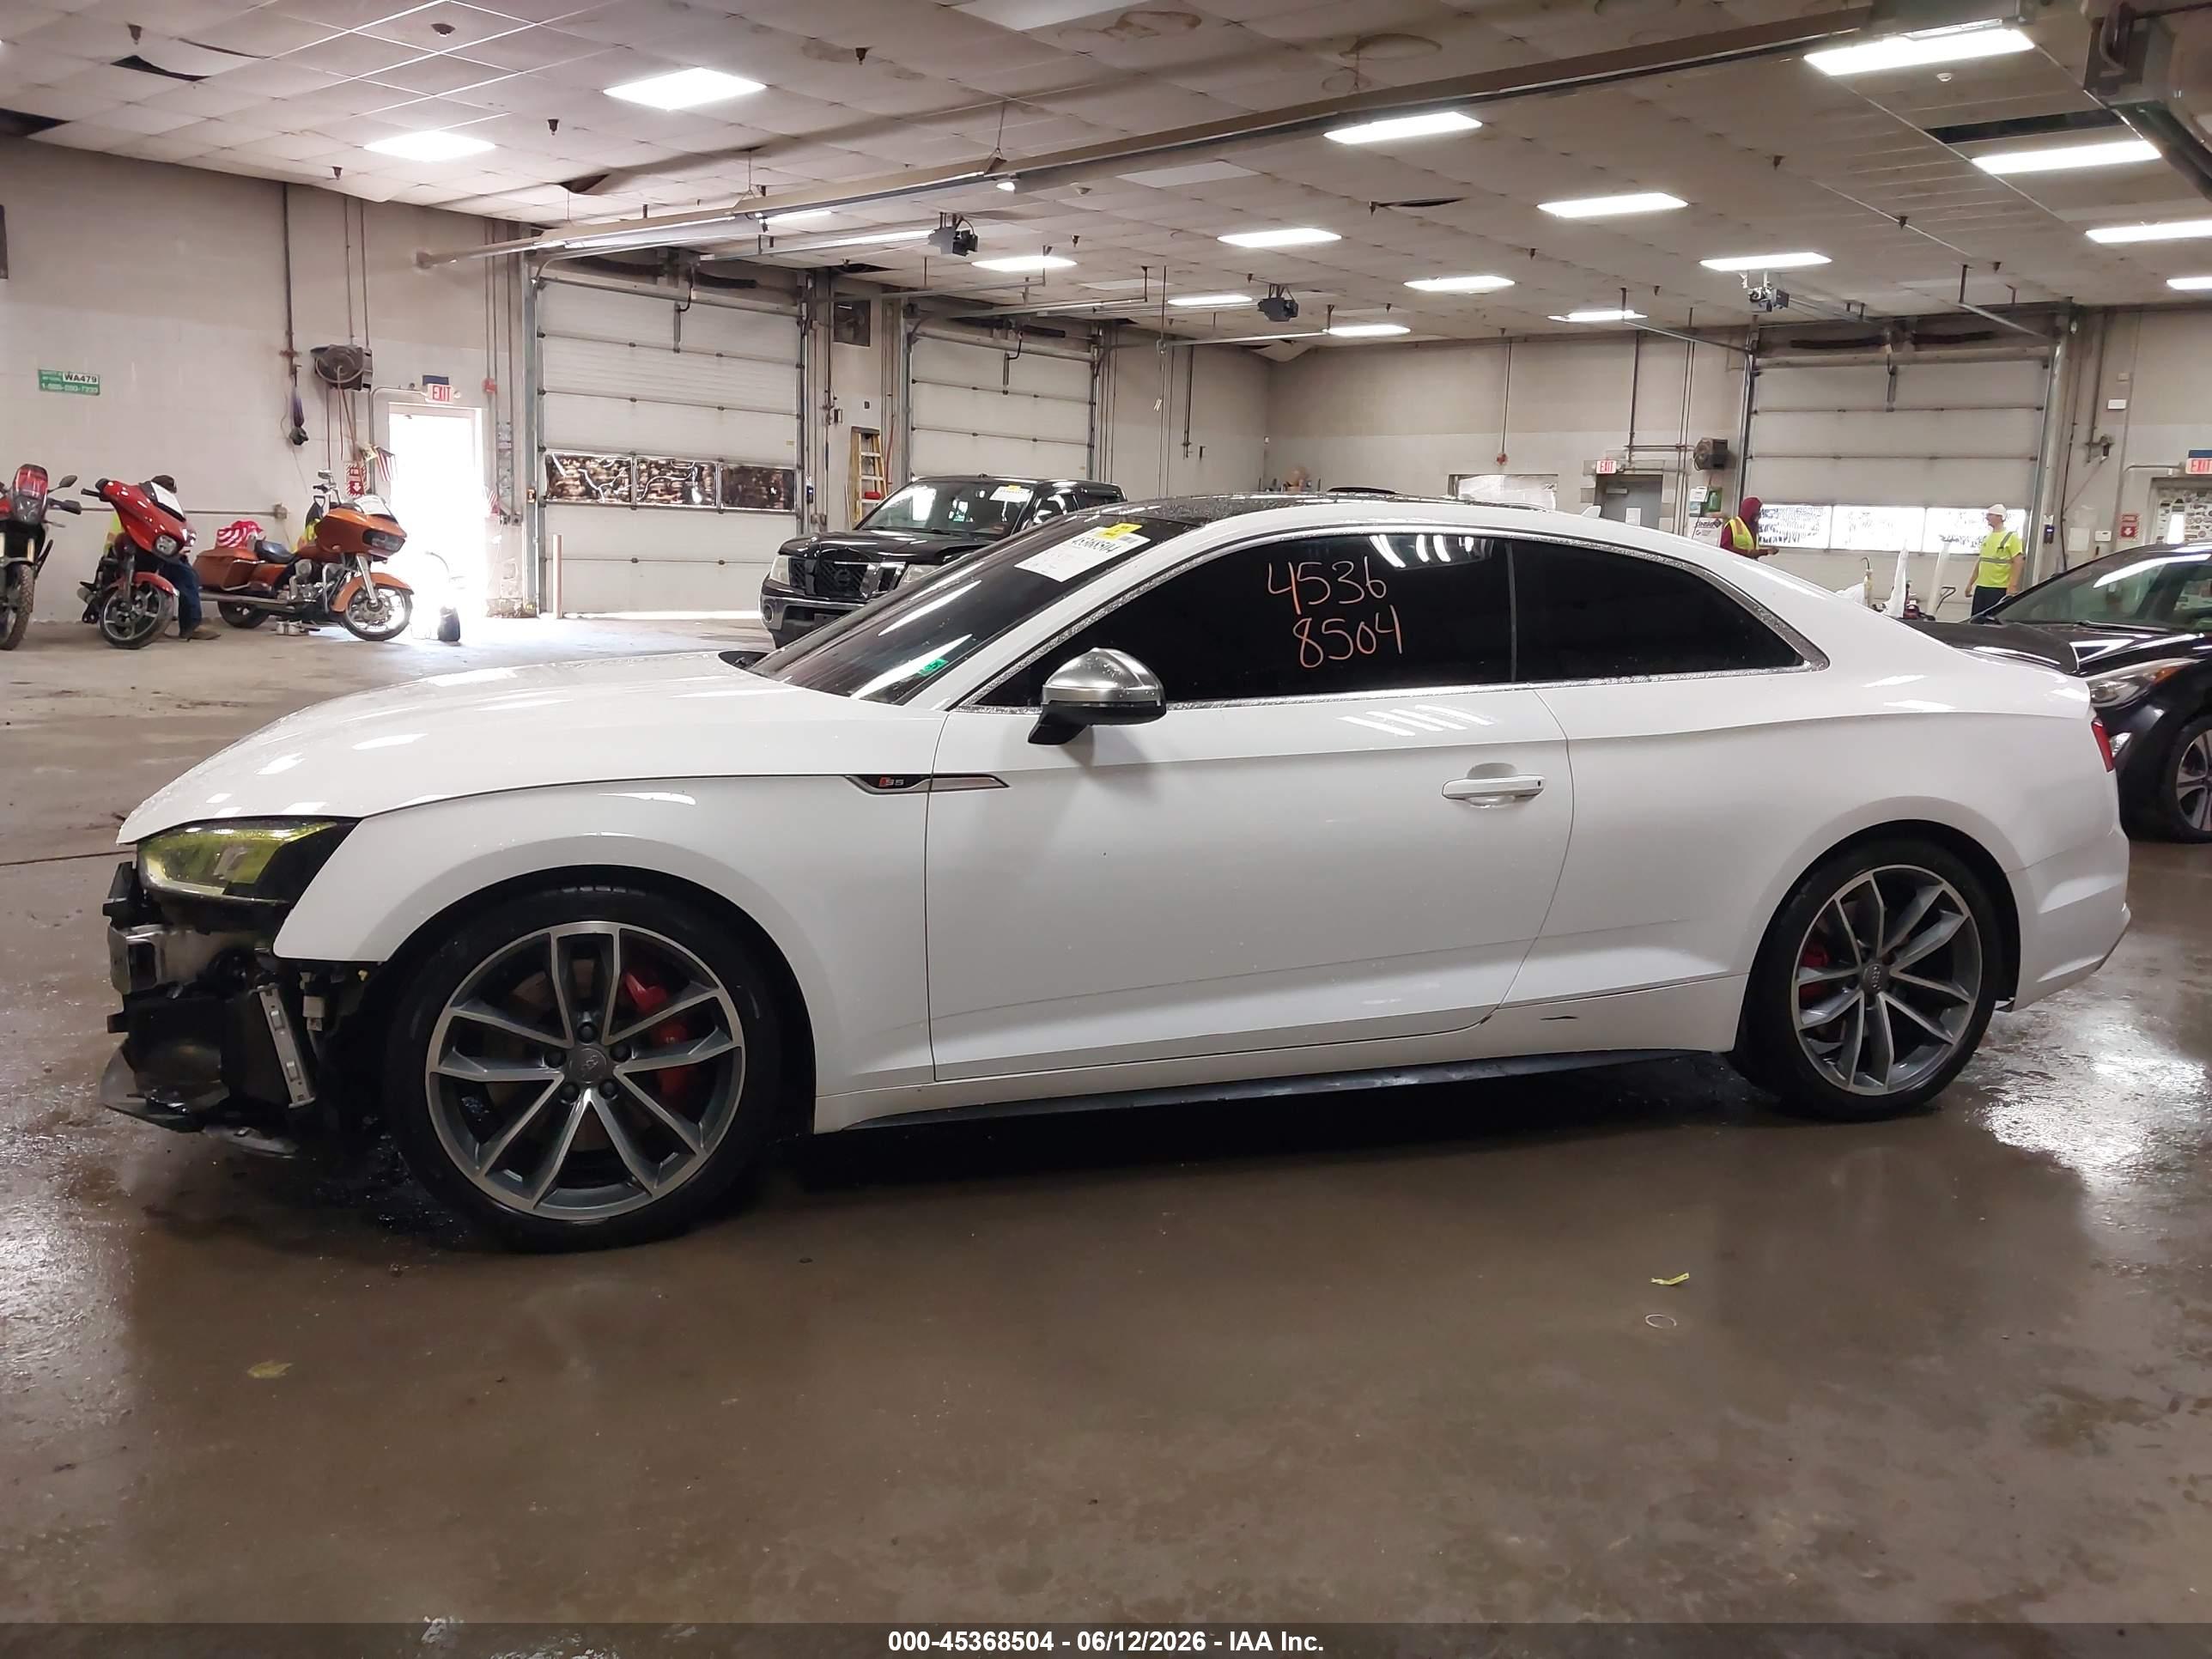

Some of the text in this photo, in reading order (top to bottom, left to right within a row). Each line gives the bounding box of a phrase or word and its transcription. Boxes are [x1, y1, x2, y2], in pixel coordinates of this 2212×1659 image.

[64, 373, 97, 383] WA479
[432, 386, 451, 402] EXIT
[1600, 461, 1613, 472] EXIT
[1267, 556, 1387, 615] 4536
[1292, 605, 1402, 668] 8504
